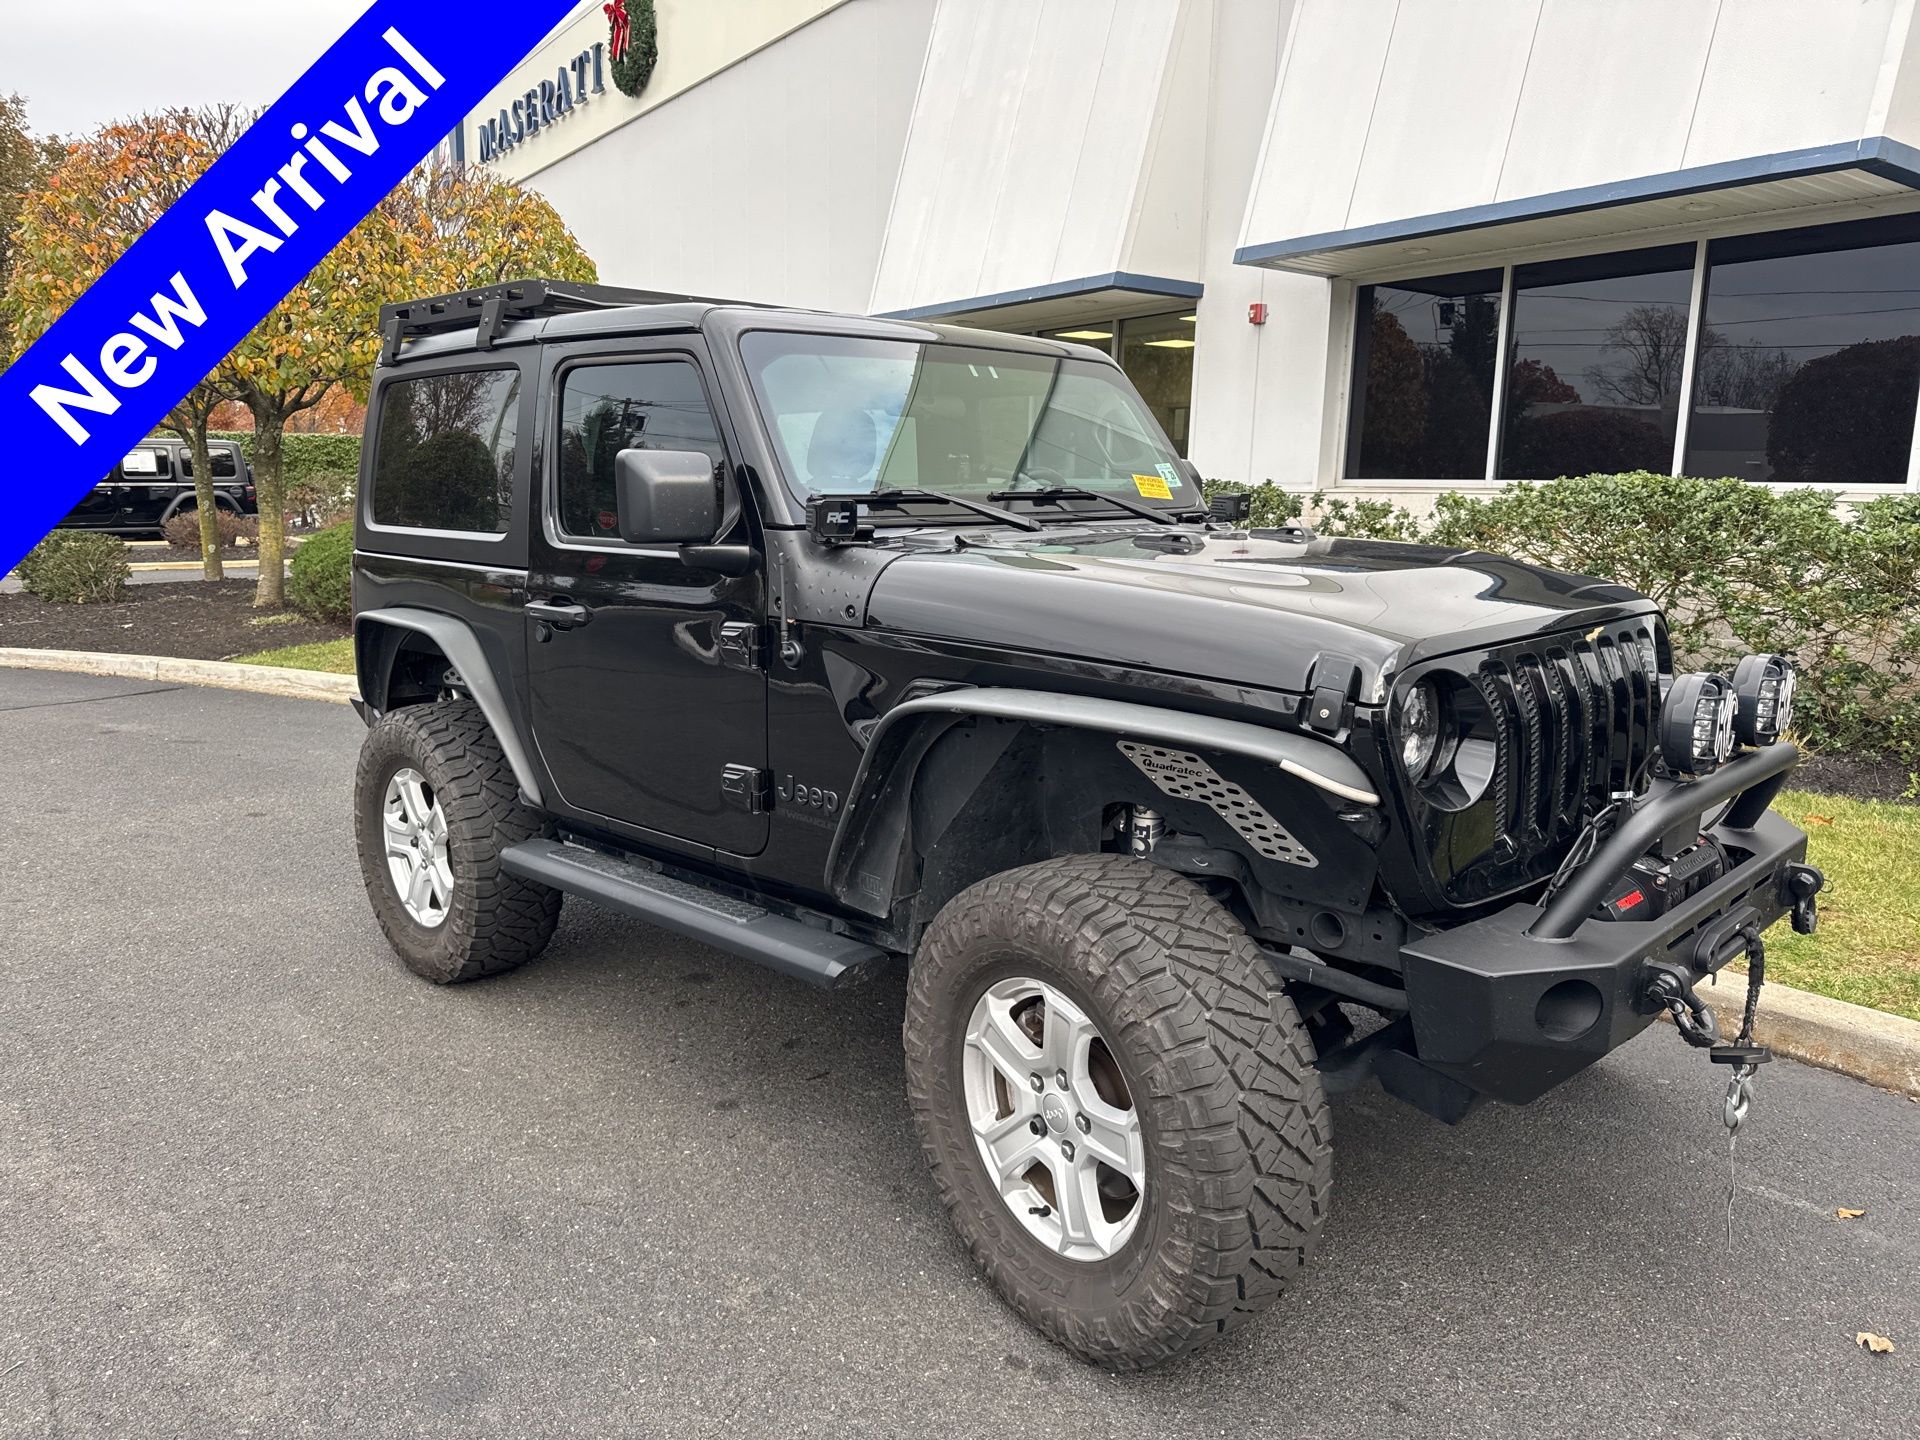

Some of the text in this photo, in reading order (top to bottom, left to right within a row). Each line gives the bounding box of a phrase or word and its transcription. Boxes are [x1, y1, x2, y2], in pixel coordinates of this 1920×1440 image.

[478, 41, 606, 165] MASERATI
[826, 511, 850, 523] RC
[1142, 758, 1203, 777] Quadratec
[777, 774, 840, 816] Jeep
